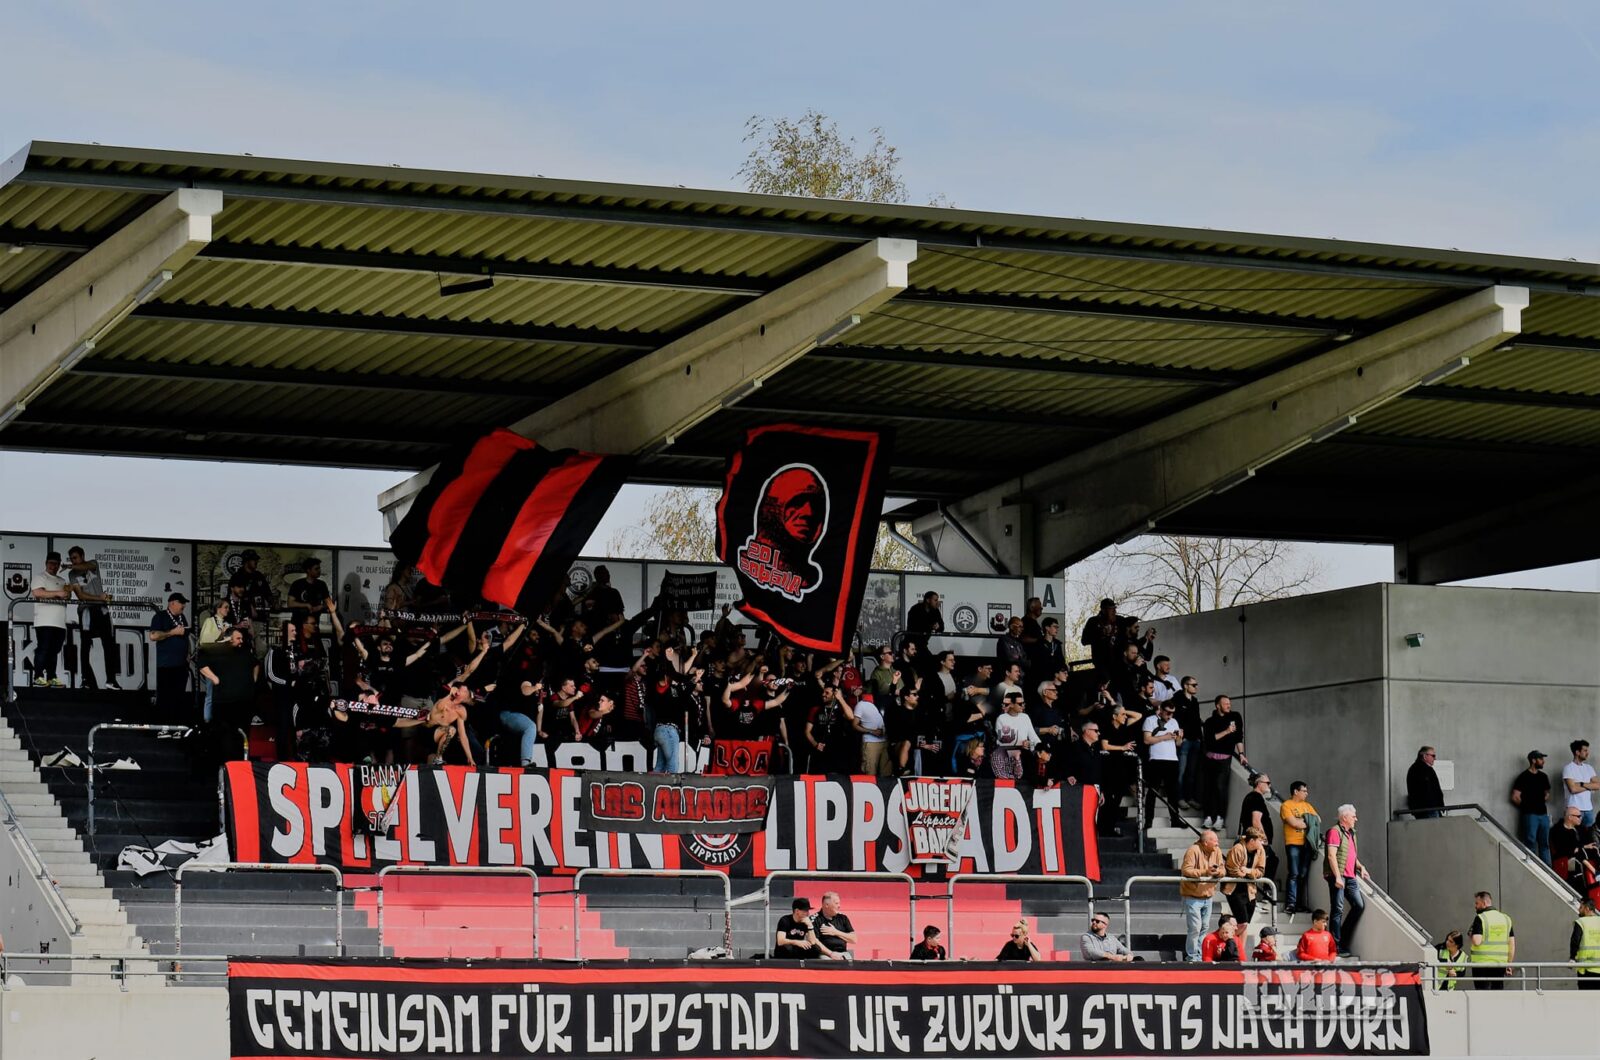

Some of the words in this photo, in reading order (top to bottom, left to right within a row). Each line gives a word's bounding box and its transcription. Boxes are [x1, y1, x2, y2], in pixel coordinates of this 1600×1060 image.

[113, 562, 154, 571] HARLINGHAUSEN
[118, 553, 149, 563] RÜHLEMANN
[365, 566, 377, 574] OLAF
[122, 580, 147, 588] FRIEDRICH
[1043, 584, 1056, 607] A
[349, 701, 369, 710] LOS
[373, 704, 419, 716] ALIADOS
[590, 783, 645, 821] LOS
[653, 785, 769, 823] ALIADOS
[766, 780, 1062, 874] LIPPSADT
[689, 844, 742, 864] LIPPSTADT
[247, 989, 481, 1053] GEMEINSAM
[492, 984, 572, 1053] FÜR
[587, 993, 806, 1053] LIPPSTADT
[820, 1019, 835, 1031] -
[848, 995, 911, 1053] NIE
[922, 985, 1071, 1052] ZURÜCK
[1082, 994, 1203, 1051] STETS
[1211, 994, 1305, 1050] NACH
[1316, 994, 1410, 1051] VORN
